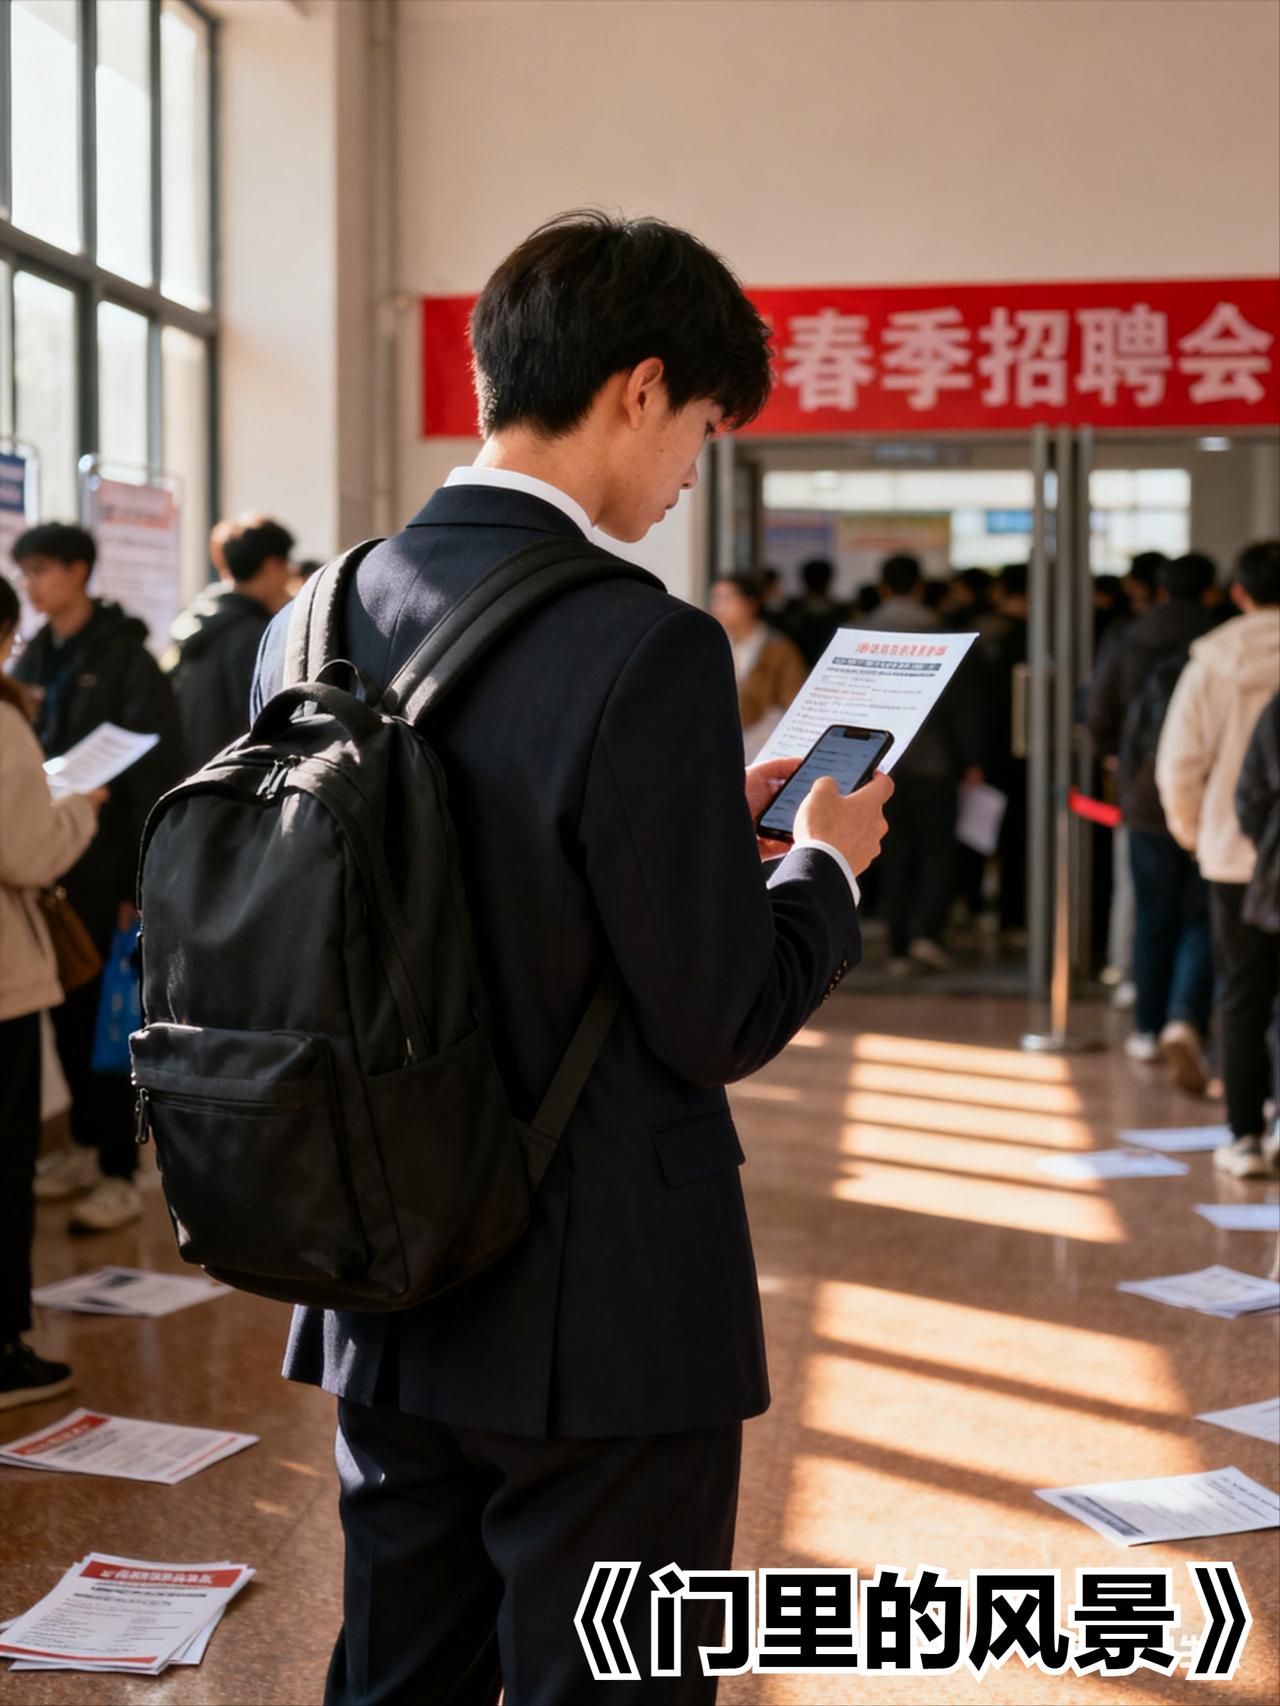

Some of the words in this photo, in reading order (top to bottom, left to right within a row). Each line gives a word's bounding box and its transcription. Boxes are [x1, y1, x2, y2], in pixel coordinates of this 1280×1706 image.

[765, 302, 1275, 412] 春季招聘会
